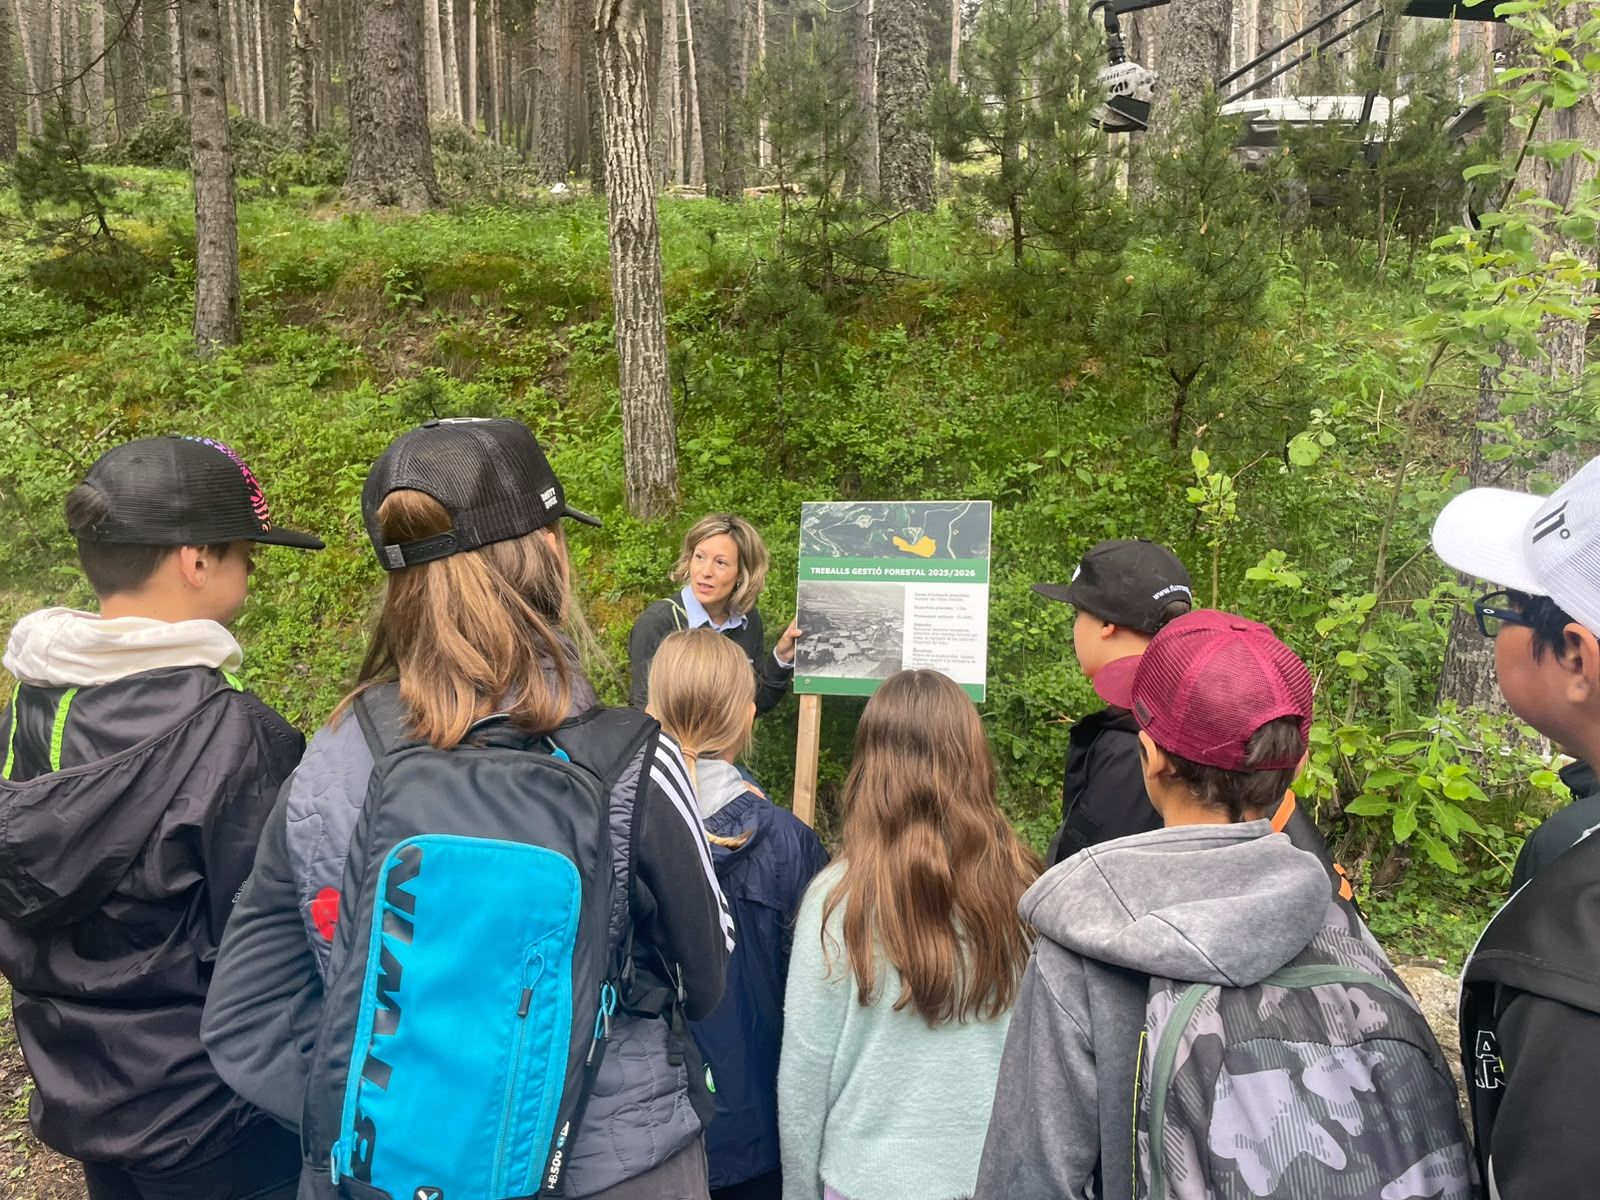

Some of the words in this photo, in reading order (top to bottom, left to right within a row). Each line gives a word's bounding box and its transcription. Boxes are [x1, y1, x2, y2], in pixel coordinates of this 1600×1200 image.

[810, 567, 850, 575] TREBALLS
[851, 566, 883, 576] GESTIÓ
[883, 568, 926, 577] FORESTAL
[927, 568, 976, 577] 2025/2026
[547, 1150, 563, 1190] HB500
